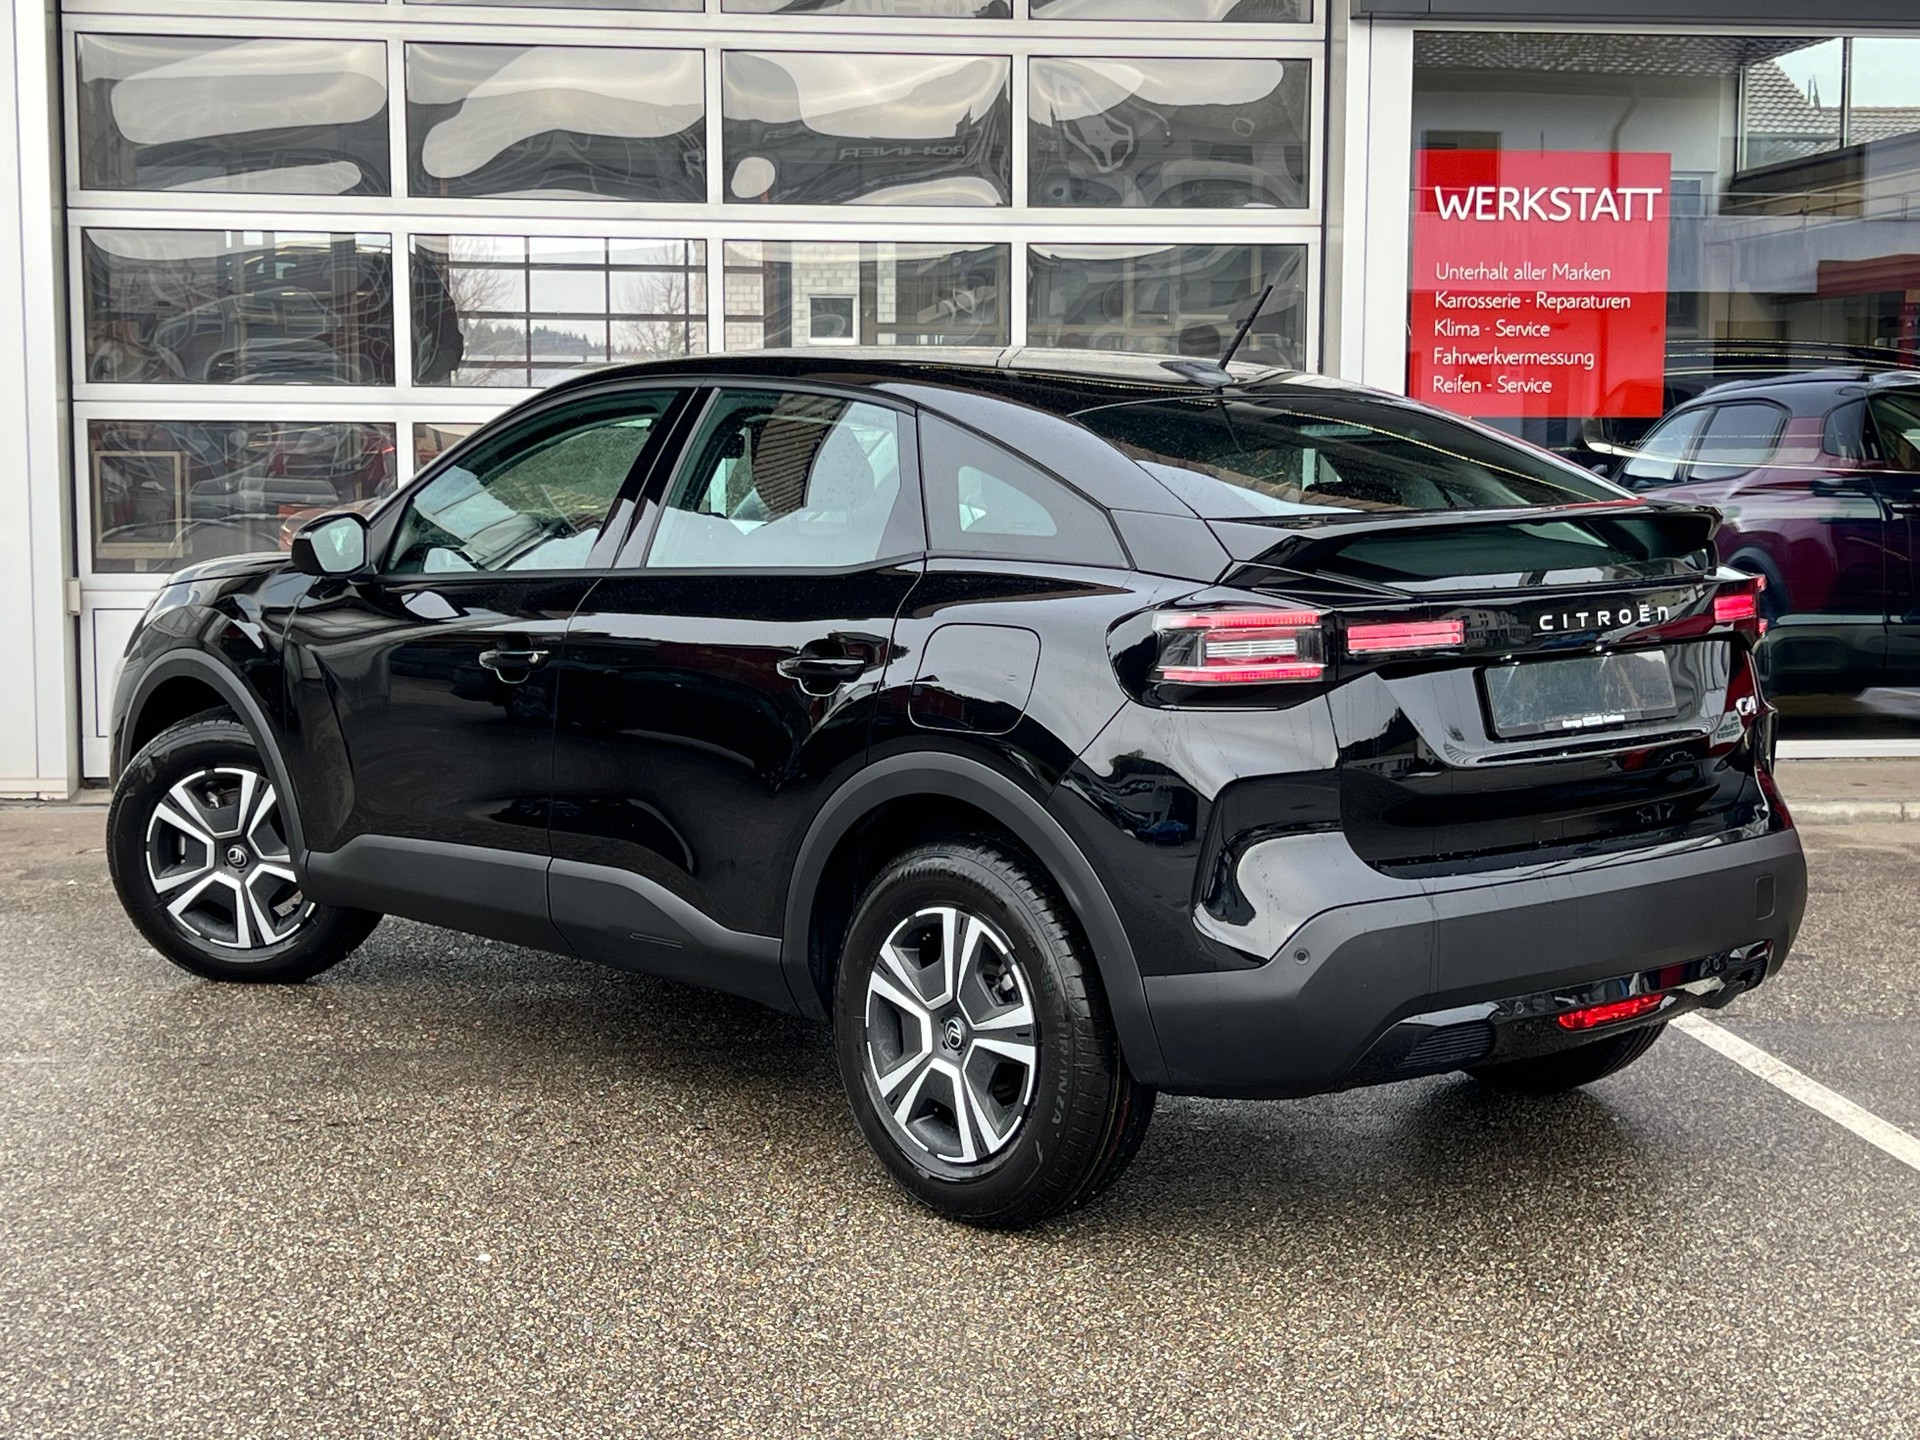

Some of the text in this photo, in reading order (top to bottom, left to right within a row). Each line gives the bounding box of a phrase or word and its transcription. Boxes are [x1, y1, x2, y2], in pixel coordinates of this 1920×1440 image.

[1434, 186, 1663, 222] WERKSTATT
[1436, 262, 1611, 281] Unterhalt aller Marken
[1434, 291, 1521, 309] Karrosserie
[1536, 291, 1631, 313] Reparaturen
[1434, 319, 1480, 337] Klima
[1495, 319, 1550, 337] Service
[1433, 347, 1595, 370] Fahrwerkvermessung
[1432, 375, 1481, 393] Reifen
[1497, 375, 1552, 393] Service
[1539, 604, 1670, 631] CITROËN
[1735, 695, 1757, 717] C4
